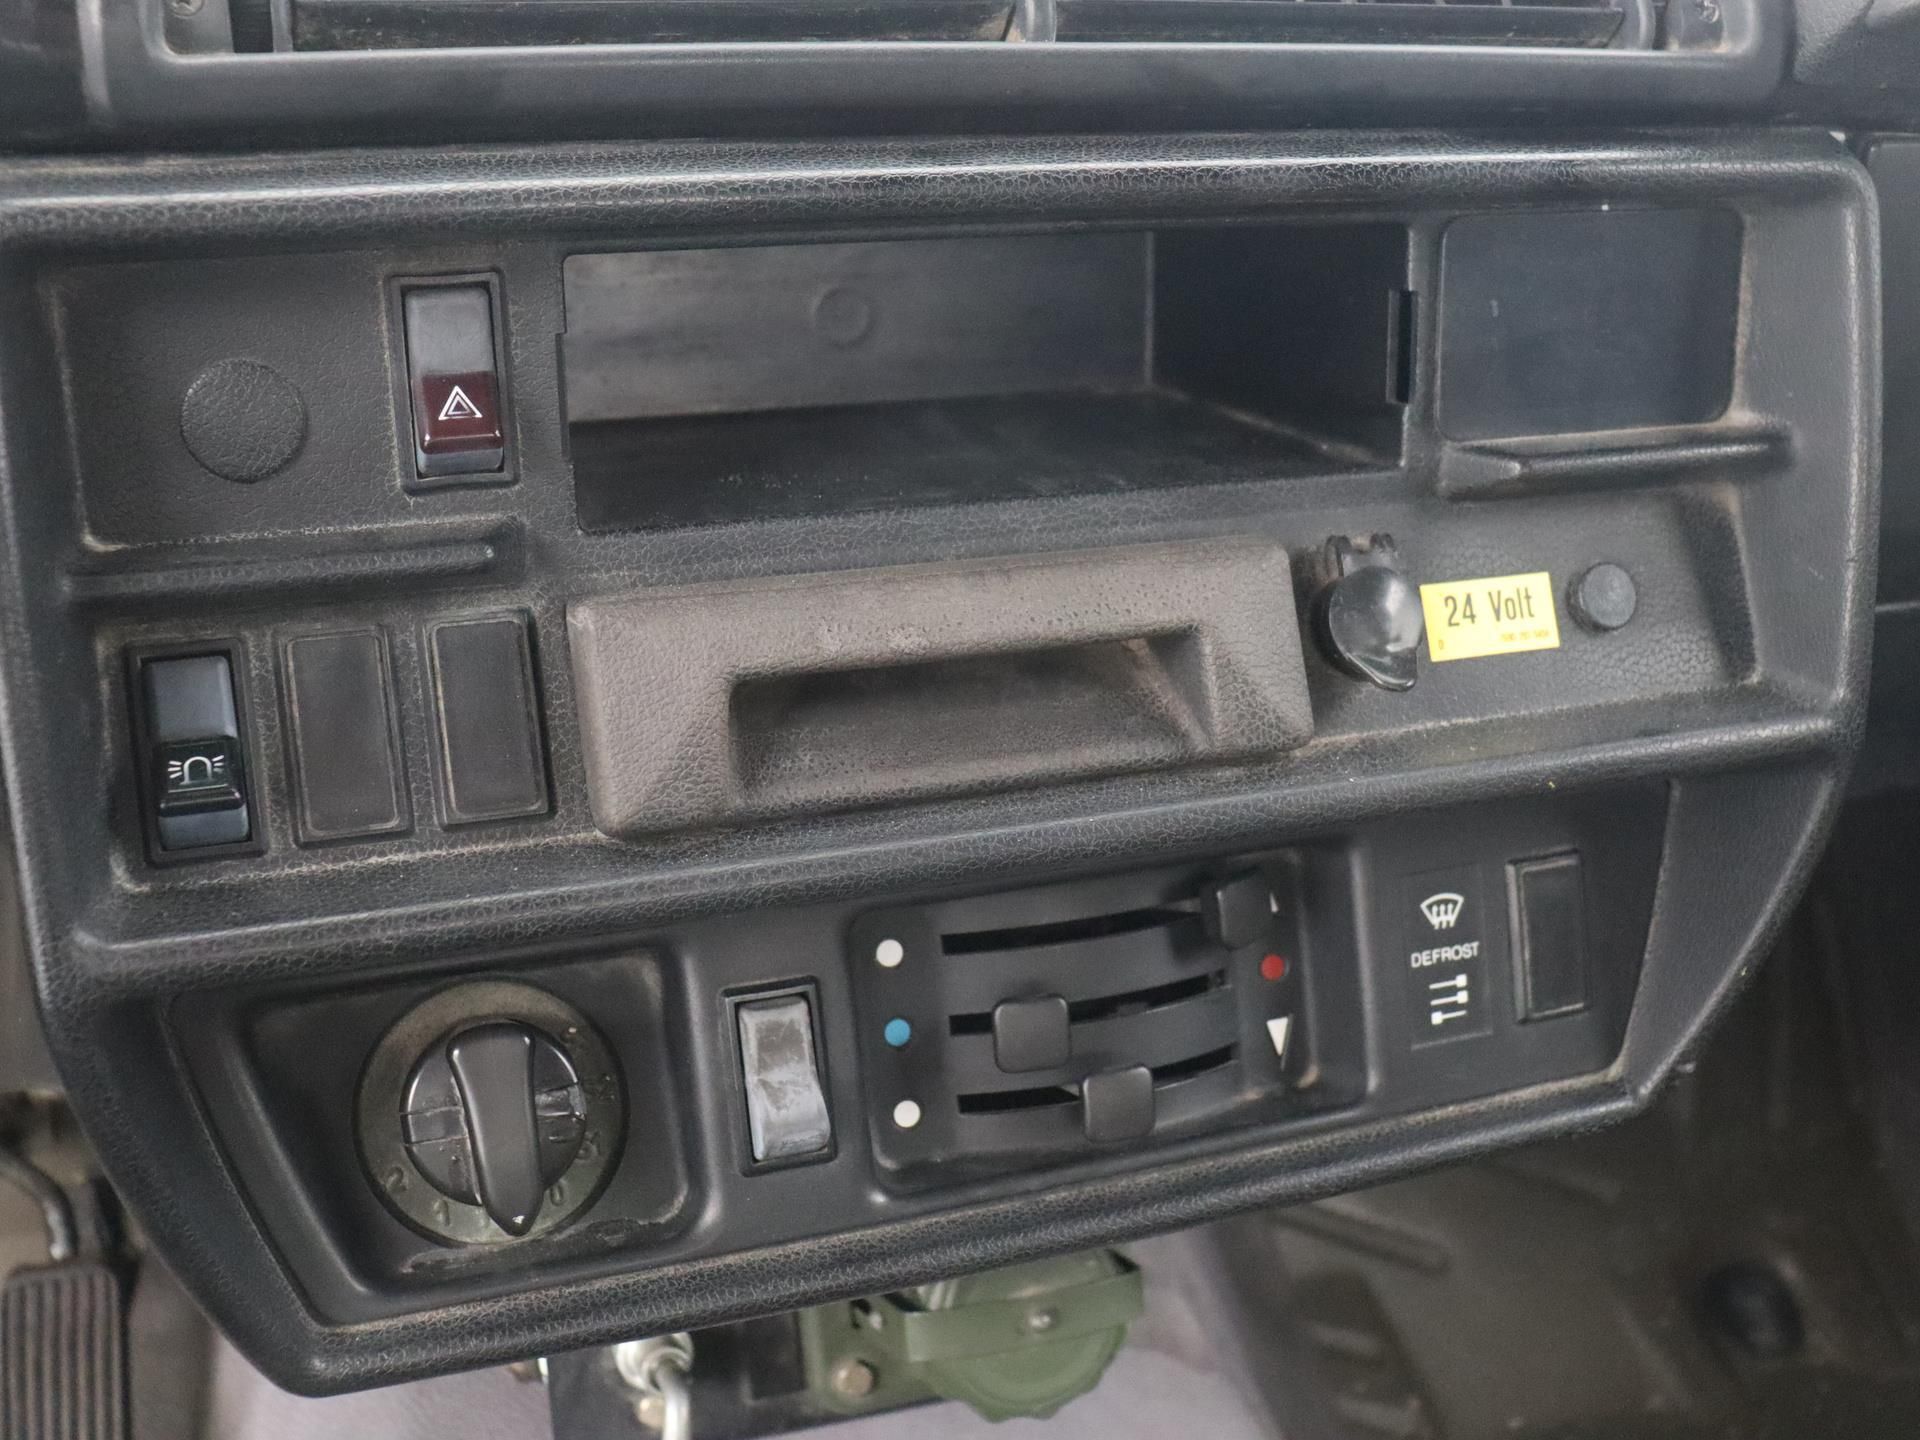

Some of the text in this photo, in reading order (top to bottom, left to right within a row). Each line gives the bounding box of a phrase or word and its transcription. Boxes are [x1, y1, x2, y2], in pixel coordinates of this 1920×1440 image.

[1444, 587, 1535, 627] 24 Volt
[1411, 941, 1479, 968] DEFROST
